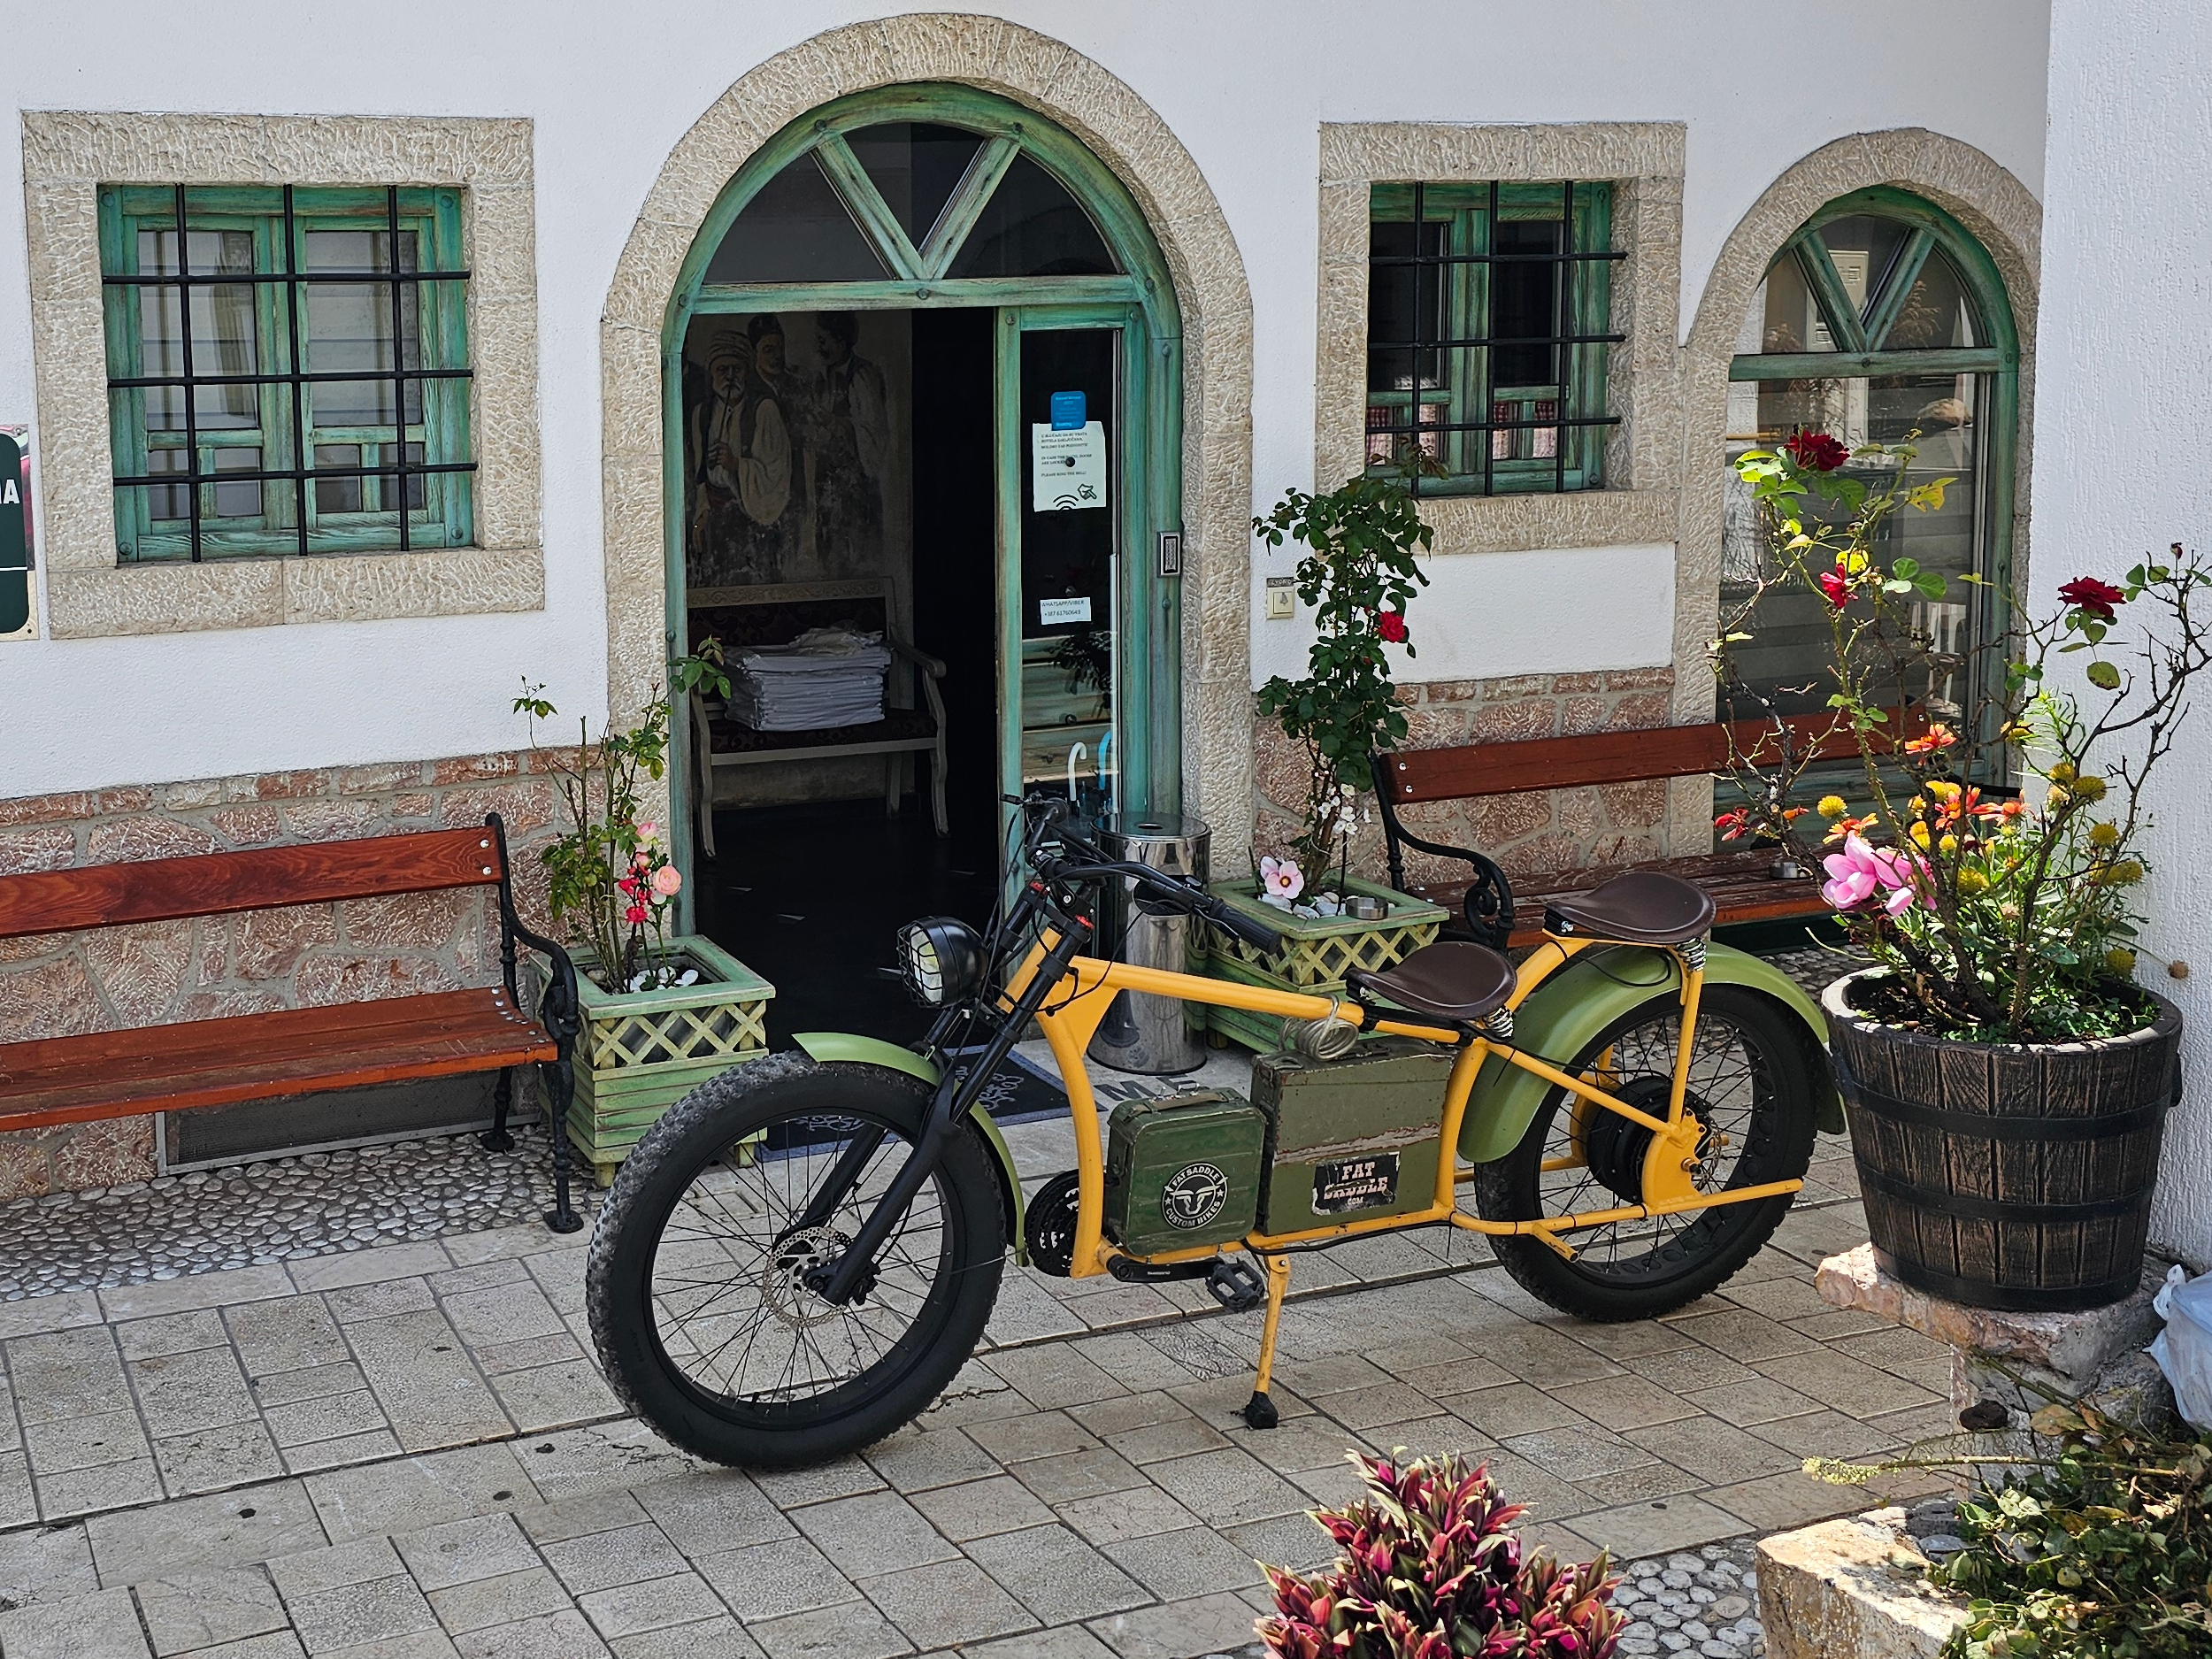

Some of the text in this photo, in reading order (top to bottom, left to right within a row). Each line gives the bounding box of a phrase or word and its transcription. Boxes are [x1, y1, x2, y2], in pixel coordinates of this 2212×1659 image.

[0, 480, 19, 503] A
[1187, 1166, 1220, 1181] SADDLE
[1341, 1161, 1376, 1180] FAT
[1166, 1201, 1220, 1227] CUSTOM BIKES
